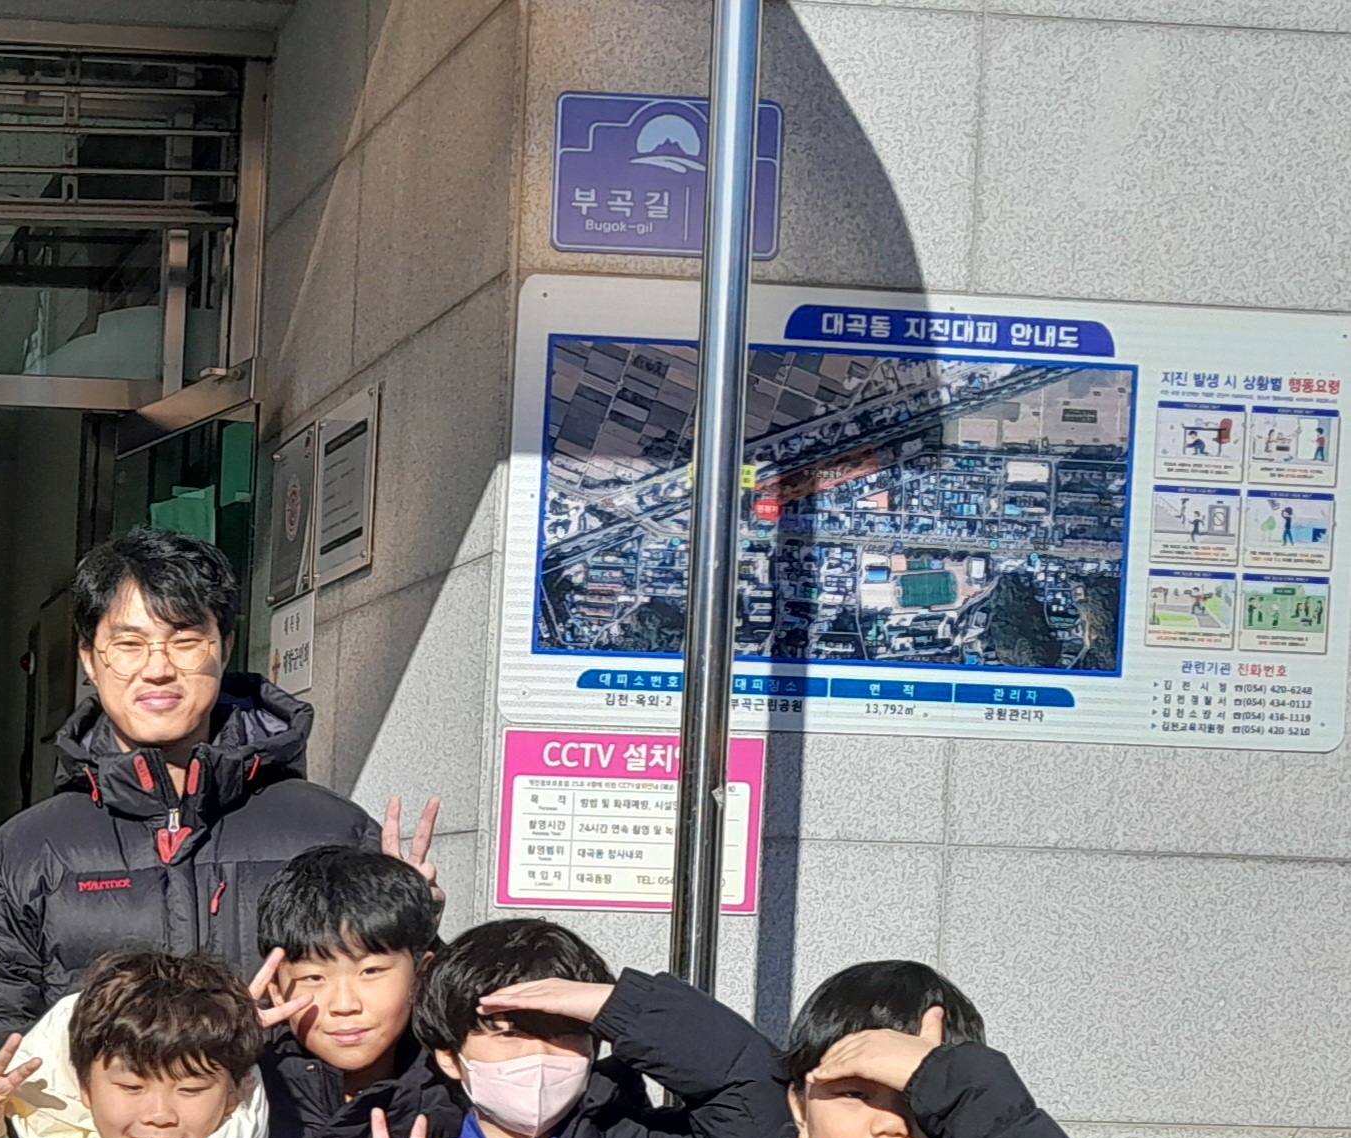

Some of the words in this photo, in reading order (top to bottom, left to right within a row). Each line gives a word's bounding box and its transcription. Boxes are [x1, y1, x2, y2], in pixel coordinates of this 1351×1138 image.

[571, 187, 670, 219] 부곡길
[585, 219, 653, 235] Bugok-gil
[821, 313, 892, 338] 대곡동
[904, 316, 998, 344] 지진대피
[1011, 322, 1079, 349] 안내도
[1161, 371, 1188, 387] 지진
[1193, 373, 1219, 389] 발생
[1224, 375, 1237, 389] 시
[1243, 375, 1283, 392] 상황별
[1288, 377, 1341, 395] 행동요령
[1181, 660, 1231, 675] 관련기관
[1237, 663, 1288, 678] 전화번호
[599, 672, 679, 688] 대피소번호
[993, 688, 1038, 704] 관리자
[984, 707, 1044, 723] 공원관리자
[543, 741, 615, 768] CCTV
[622, 743, 682, 773] 설치
[577, 848, 604, 859] 대곡동
[78, 878, 133, 892] Marmot
